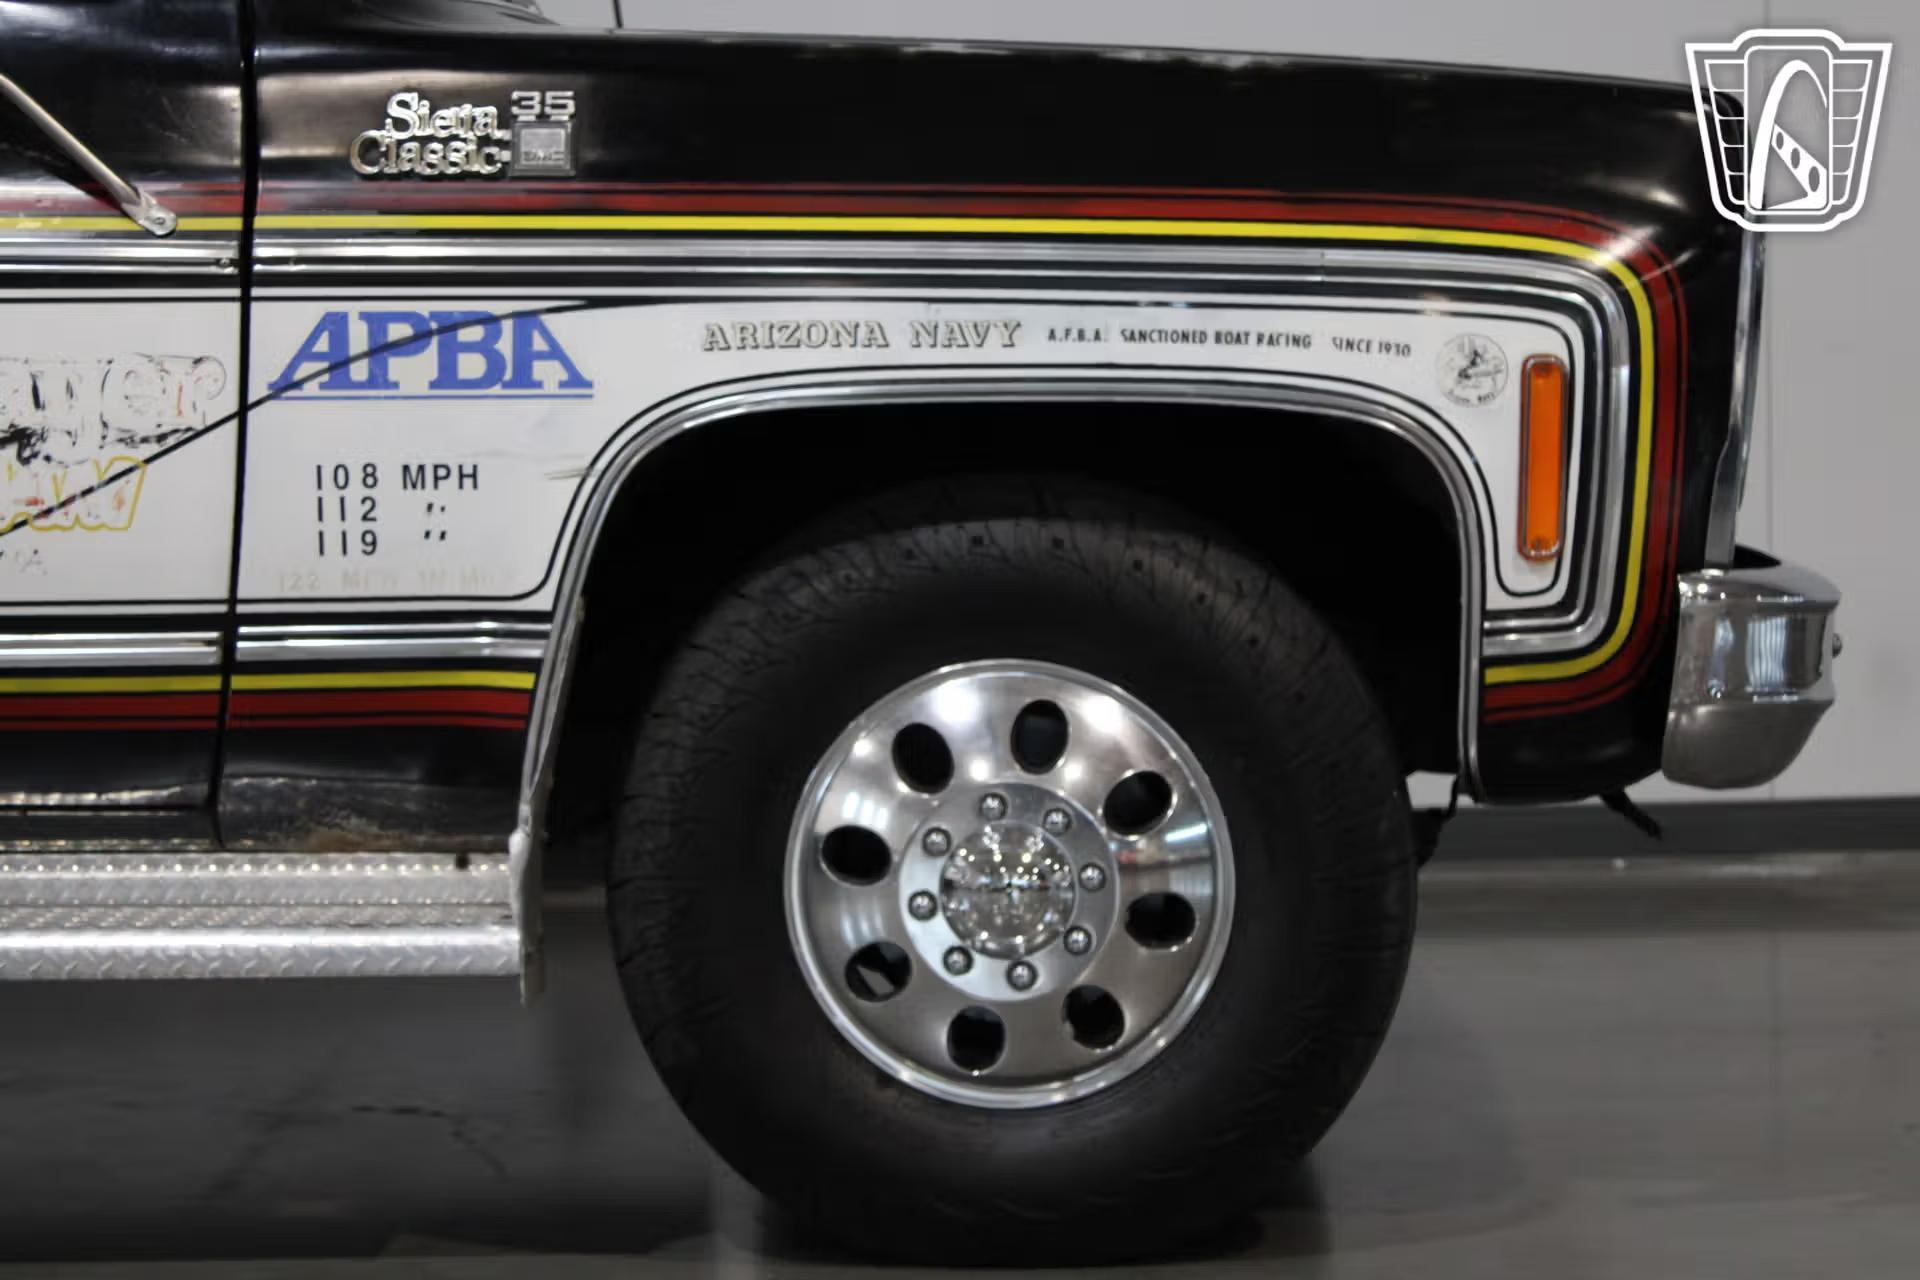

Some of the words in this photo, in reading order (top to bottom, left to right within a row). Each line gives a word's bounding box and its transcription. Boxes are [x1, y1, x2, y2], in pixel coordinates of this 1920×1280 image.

[387, 92, 508, 140] Sierra
[510, 91, 576, 117] 35
[351, 119, 502, 175] Classic
[703, 320, 889, 351] ARIZONA
[911, 320, 1022, 348] NAVY
[1120, 328, 1208, 345] SANCTIONED
[1214, 330, 1251, 346] BOAT
[1256, 332, 1312, 350] RACING
[267, 310, 594, 391] APBA
[315, 463, 379, 491] 108
[401, 463, 480, 491] MPH
[317, 495, 378, 522] 112
[318, 529, 378, 557] 119
